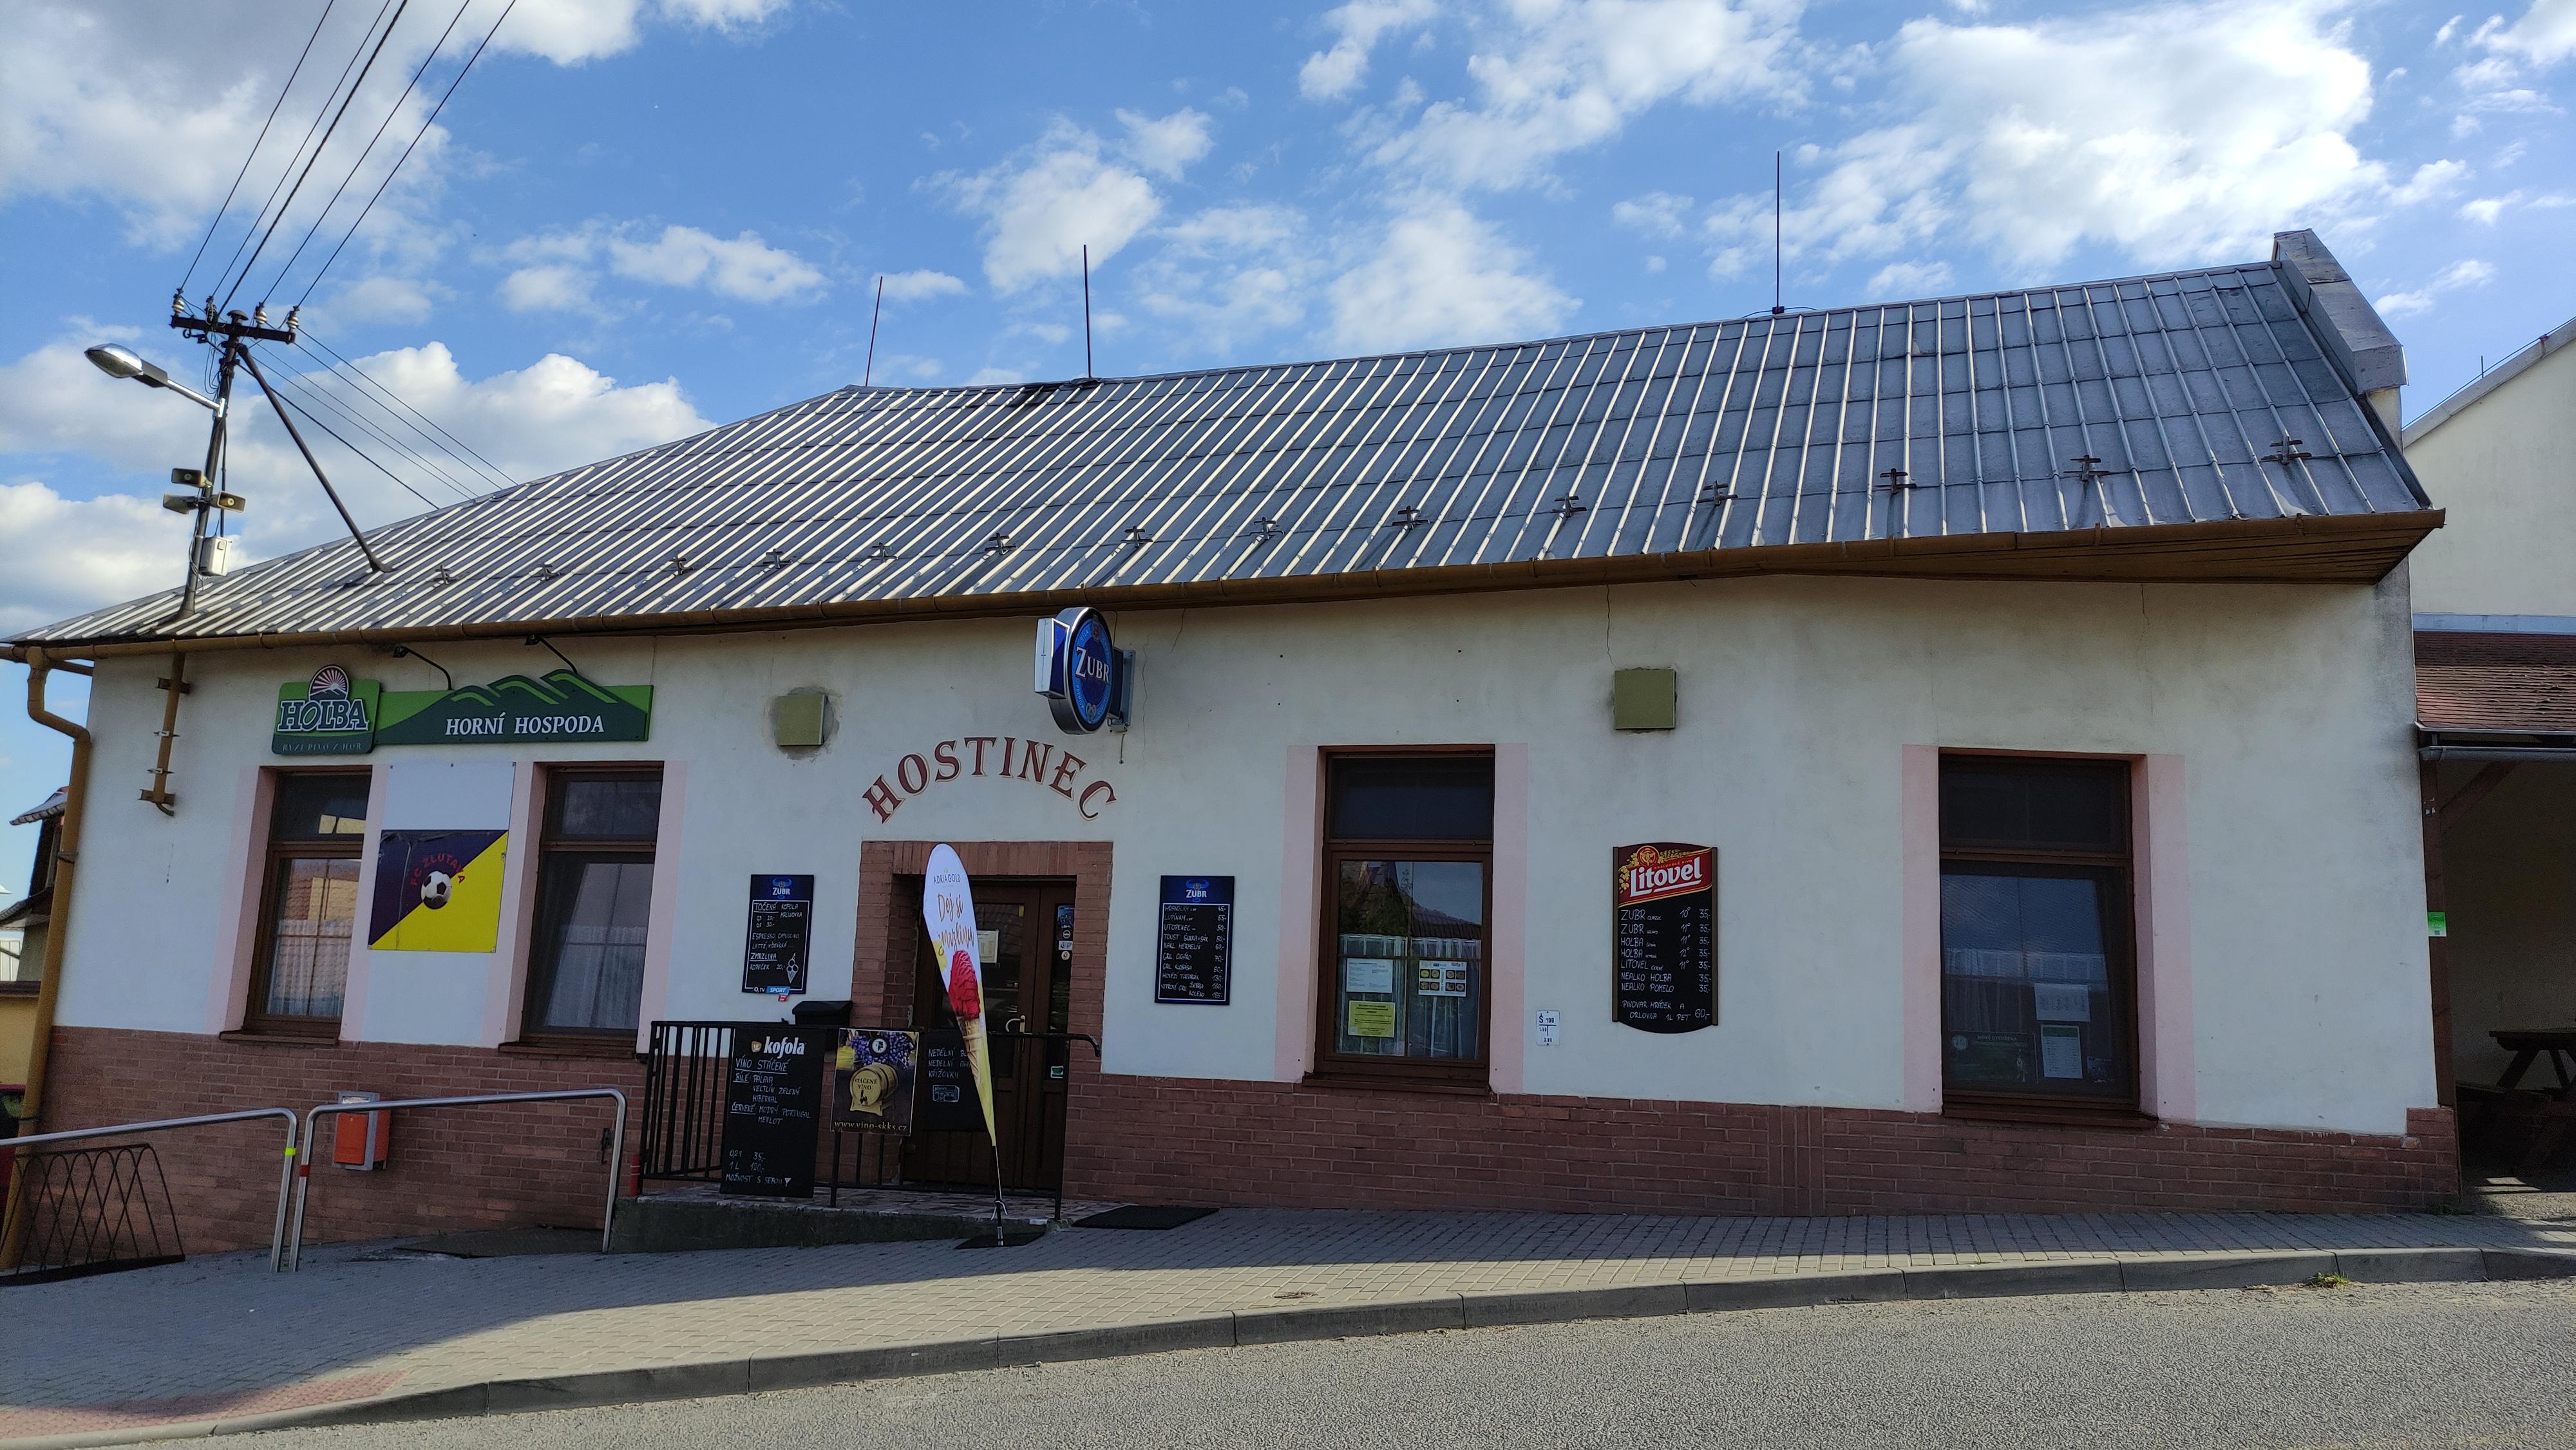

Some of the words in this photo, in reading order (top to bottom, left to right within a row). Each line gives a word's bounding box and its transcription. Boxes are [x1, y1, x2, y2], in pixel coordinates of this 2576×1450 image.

[1075, 646, 1110, 683] ZUBR
[278, 699, 370, 731] HOLBA
[446, 713, 506, 735] HORNÍ
[515, 715, 604, 734] HOSPODA
[862, 737, 1117, 824] HOSTINEC
[1630, 856, 1702, 897] Litovel
[754, 902, 777, 910] TOČENÁ
[938, 893, 954, 921] Dej
[957, 894, 963, 918] si
[1621, 910, 1646, 921] ZUBR
[1699, 909, 1710, 919] 35,-
[1621, 923, 1644, 934] ZUBR
[1700, 924, 1710, 932] 35,-
[1621, 937, 1643, 946] HOLBA
[1699, 936, 1710, 945] 35,-
[1621, 949, 1643, 958] HOLBA
[1699, 949, 1711, 957] 35,-
[1621, 960, 1649, 969] LITOVEL
[1699, 961, 1710, 970] 35,-
[1622, 972, 1645, 981] NEALKO
[1699, 974, 1712, 983] 35,-
[1622, 982, 1645, 991] NEALKO
[1650, 983, 1674, 992] POMELO
[1699, 984, 1710, 993] 35,-
[1622, 1000, 1647, 1008] PIVOVAR
[1695, 1009, 1710, 1020] 60,-
[763, 1036, 805, 1059] kofola
[736, 1055, 752, 1068] VÍNO
